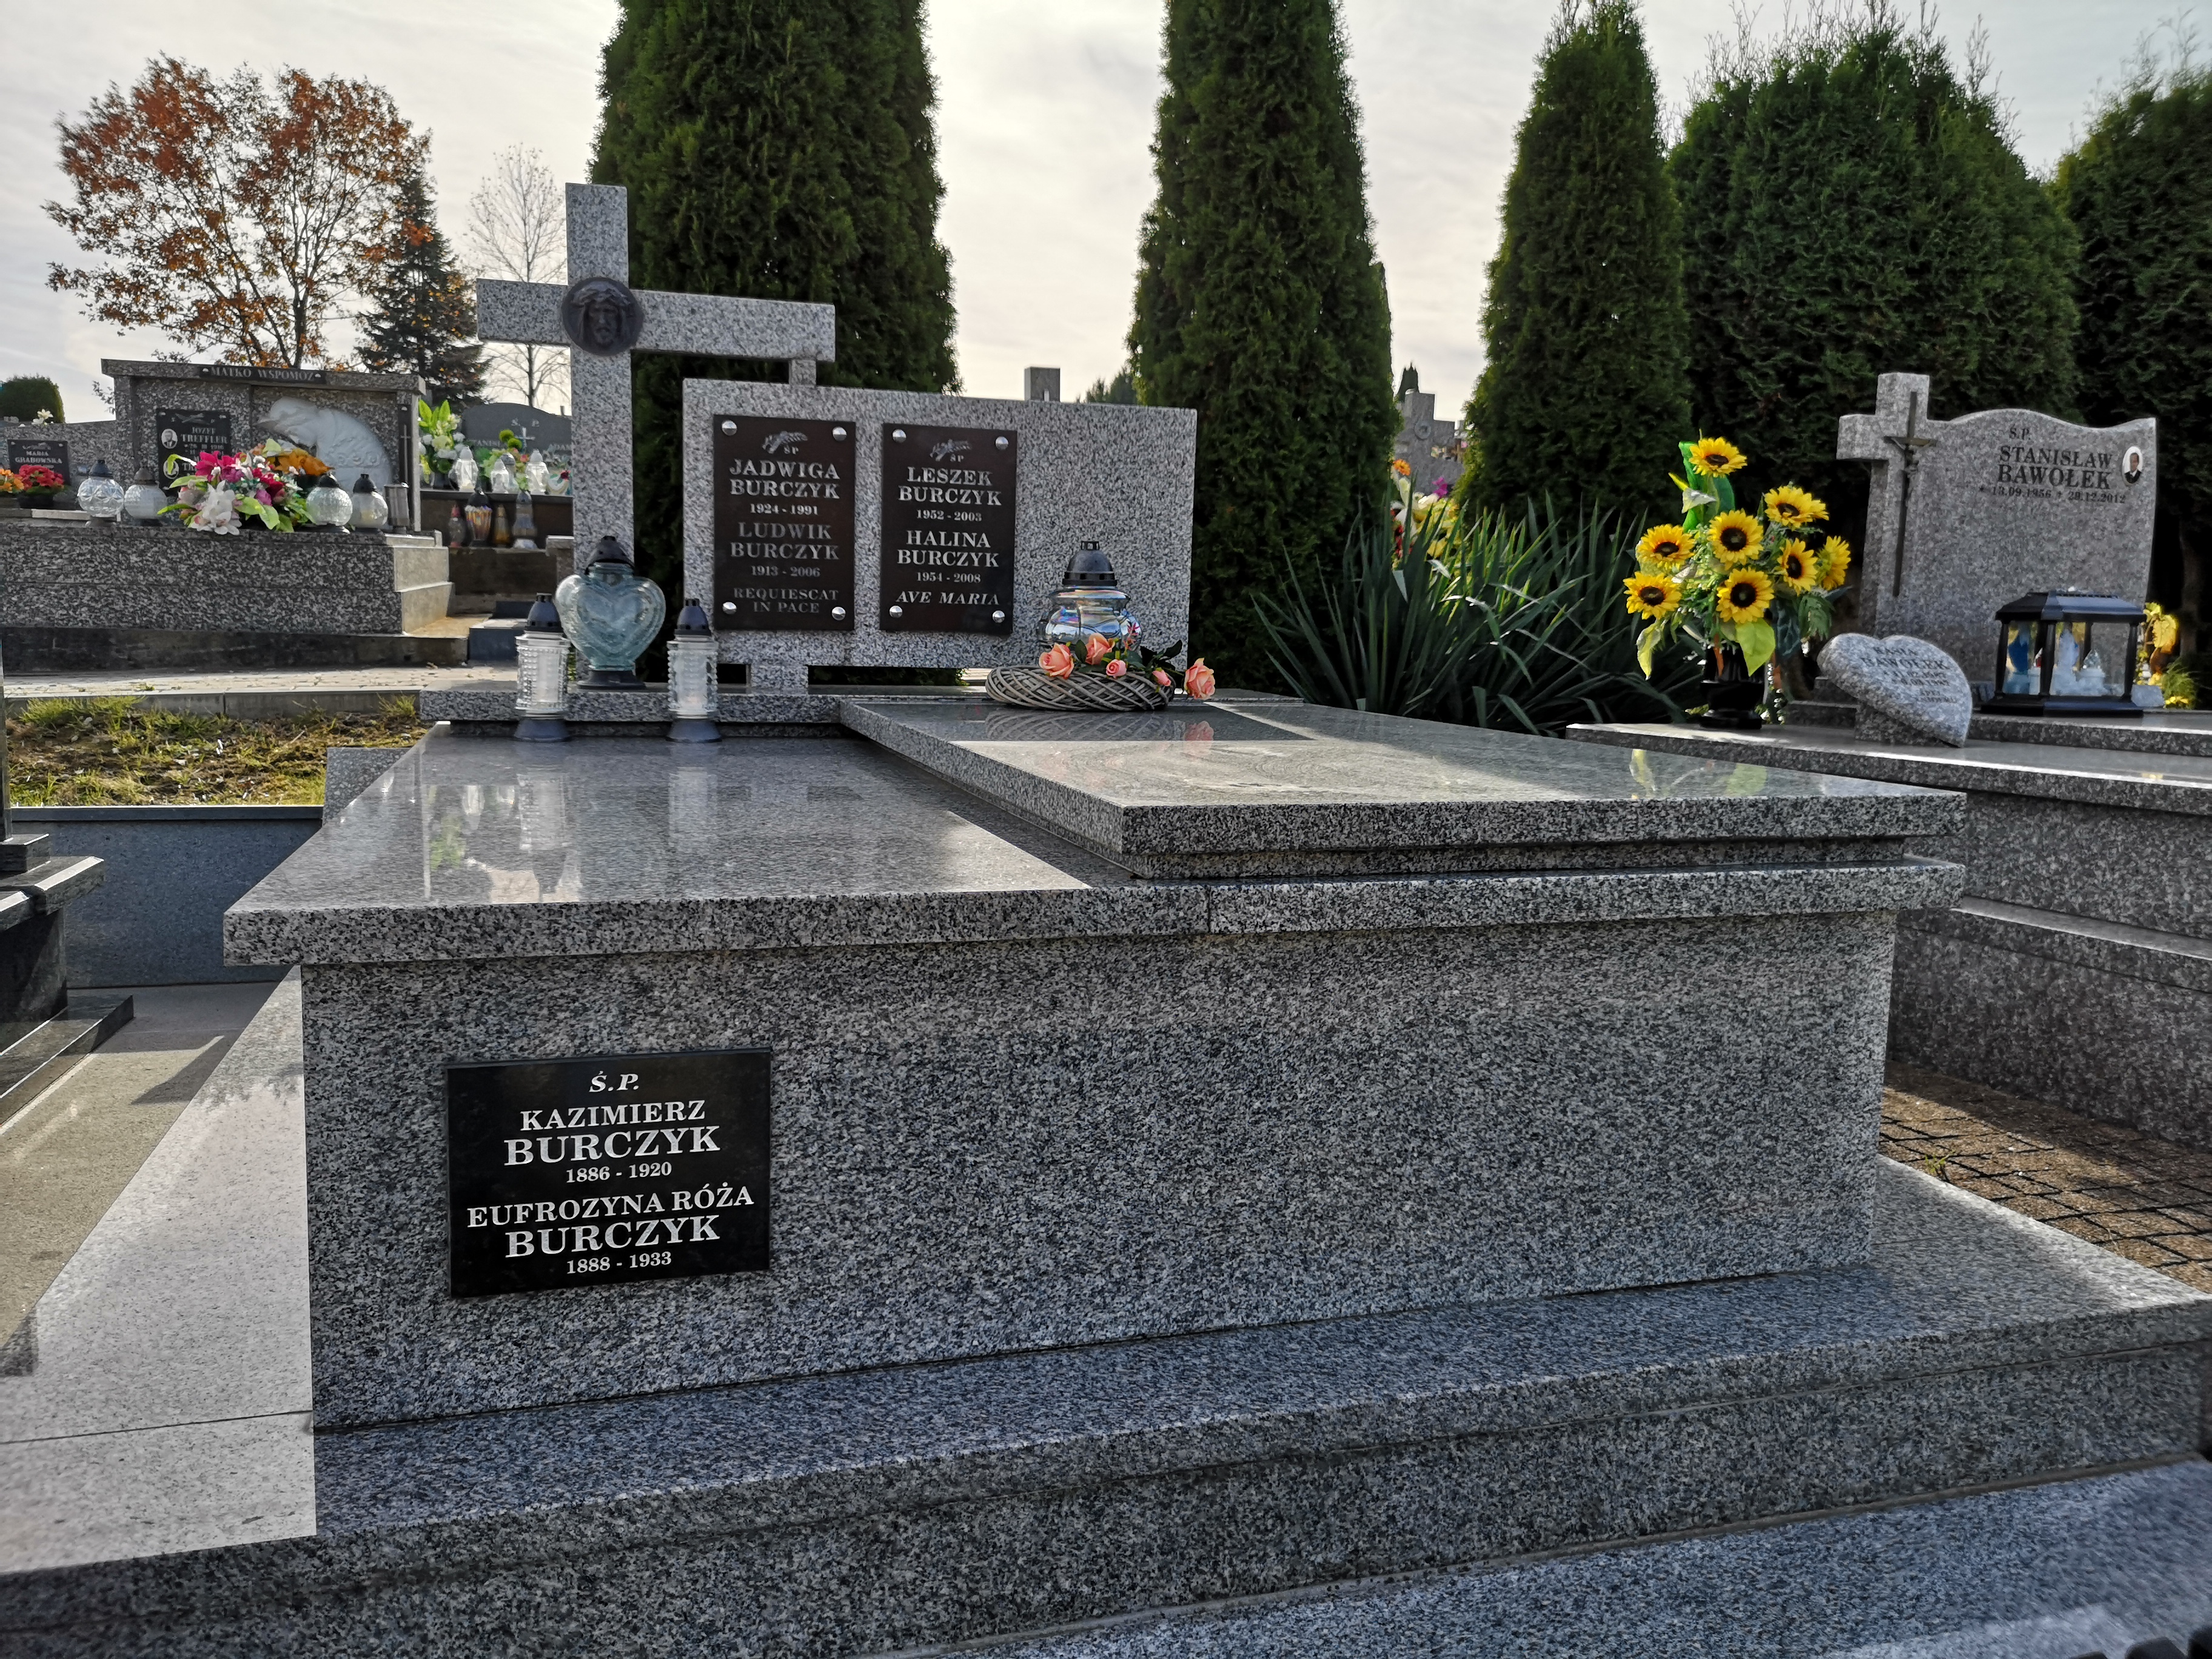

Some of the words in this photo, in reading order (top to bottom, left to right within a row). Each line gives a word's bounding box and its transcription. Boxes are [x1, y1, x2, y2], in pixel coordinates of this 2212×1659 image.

[212, 367, 252, 378] MATKO
[729, 458, 840, 480] JADWIGA
[907, 466, 993, 486] LESZEK
[1997, 464, 2112, 489] BAWOŁEK
[729, 478, 840, 499] BURCZYK
[898, 485, 1002, 506] BURCZYK
[750, 503, 779, 514] 1924
[790, 504, 819, 515] 1991
[916, 509, 945, 520] 1952
[954, 511, 982, 521] 2003
[738, 521, 832, 540] LUDWIK
[906, 530, 991, 548] HALINA
[730, 541, 840, 560] BURCZYK
[897, 549, 999, 568] BURCZYK
[751, 565, 779, 577] 1913
[790, 566, 820, 577] 2006
[916, 572, 943, 582] 1954
[953, 573, 981, 583] 2008
[733, 587, 839, 601] REQUIESCAT
[895, 591, 932, 603] AVE
[939, 592, 999, 605] MARIA
[753, 600, 771, 612] IN
[777, 601, 819, 614] PACE
[520, 1100, 705, 1131] KAZIMIERZ
[503, 1125, 720, 1166] BURCZYK
[566, 1165, 611, 1183] 1886
[629, 1162, 672, 1179] 1920
[467, 1193, 665, 1228] EUFROZYNA
[671, 1182, 754, 1212] RÓŻA
[504, 1215, 720, 1258] BURCZYK
[566, 1256, 611, 1274] 1888
[629, 1252, 672, 1269] 1933
